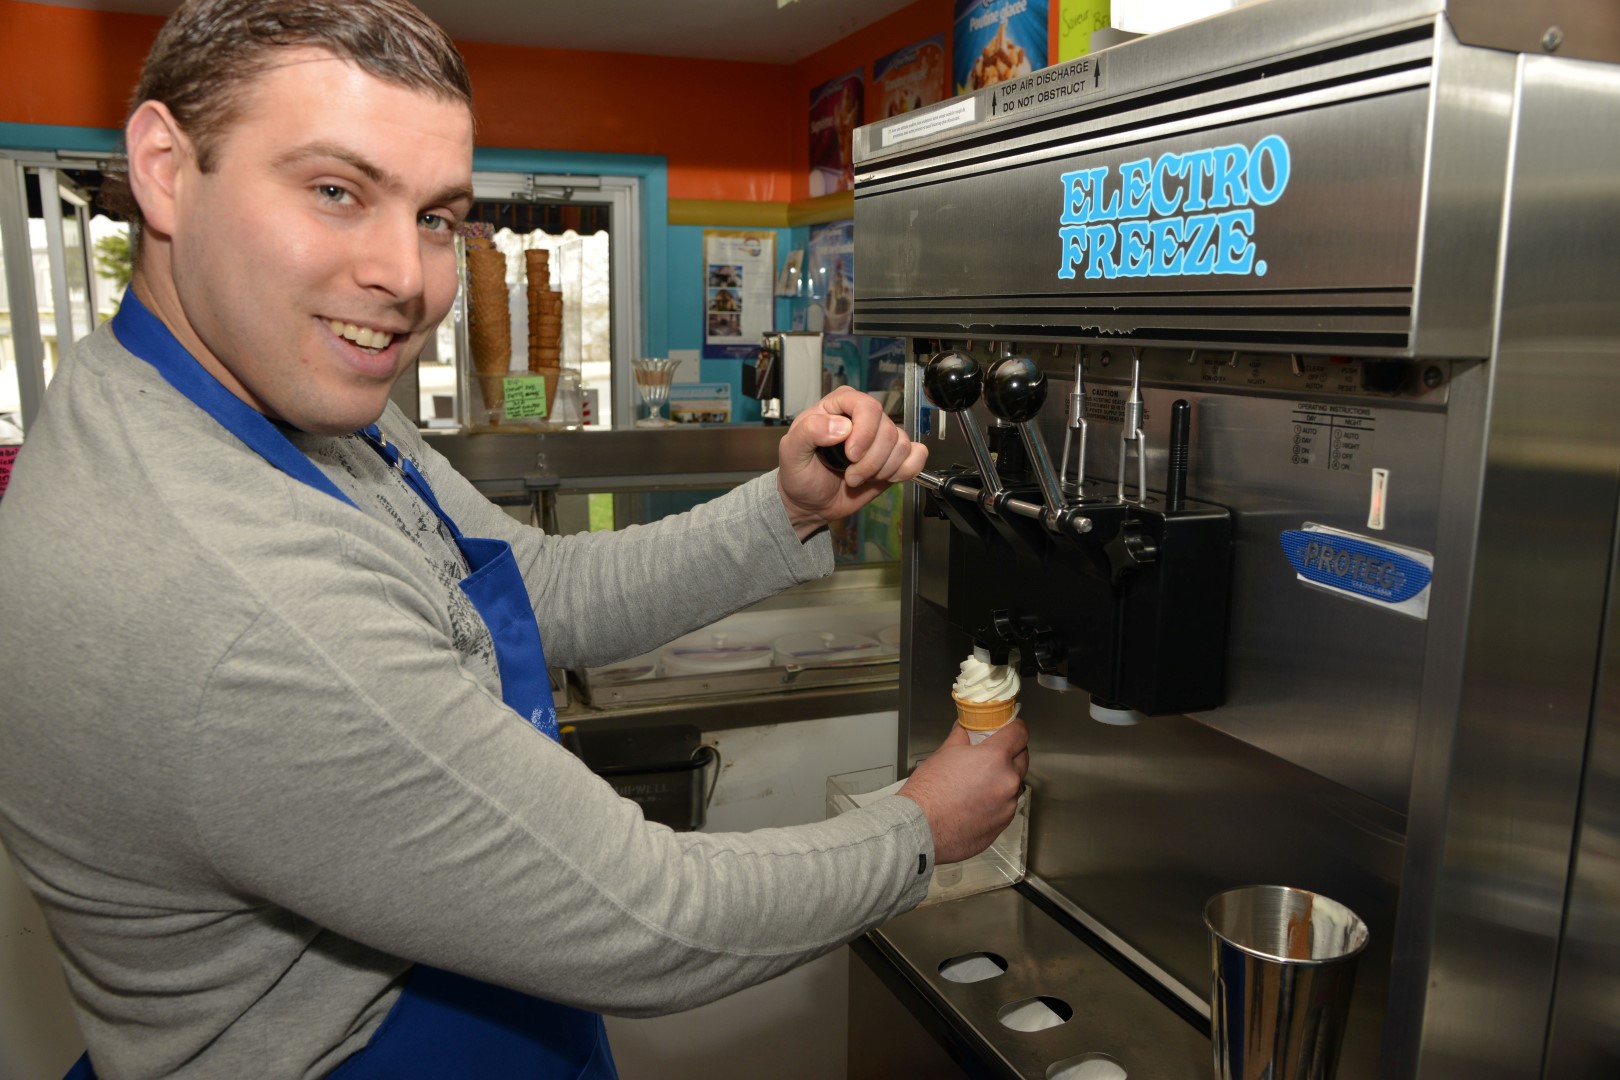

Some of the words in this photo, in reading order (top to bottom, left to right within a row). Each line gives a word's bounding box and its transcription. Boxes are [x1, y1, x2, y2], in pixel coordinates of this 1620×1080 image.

[1002, 83, 1016, 97] TOP
[1020, 79, 1033, 92] AIR
[1037, 62, 1089, 87] DISCHARGE
[1003, 100, 1014, 113] DO
[1018, 96, 1034, 109] NOT
[1038, 81, 1085, 101] OBSTRUCT
[1060, 134, 1290, 225] ELECTRO
[1092, 389, 1118, 397] CAUTION
[1298, 403, 1327, 412] OPERATING
[1330, 406, 1370, 416] INSTRUCTIONS
